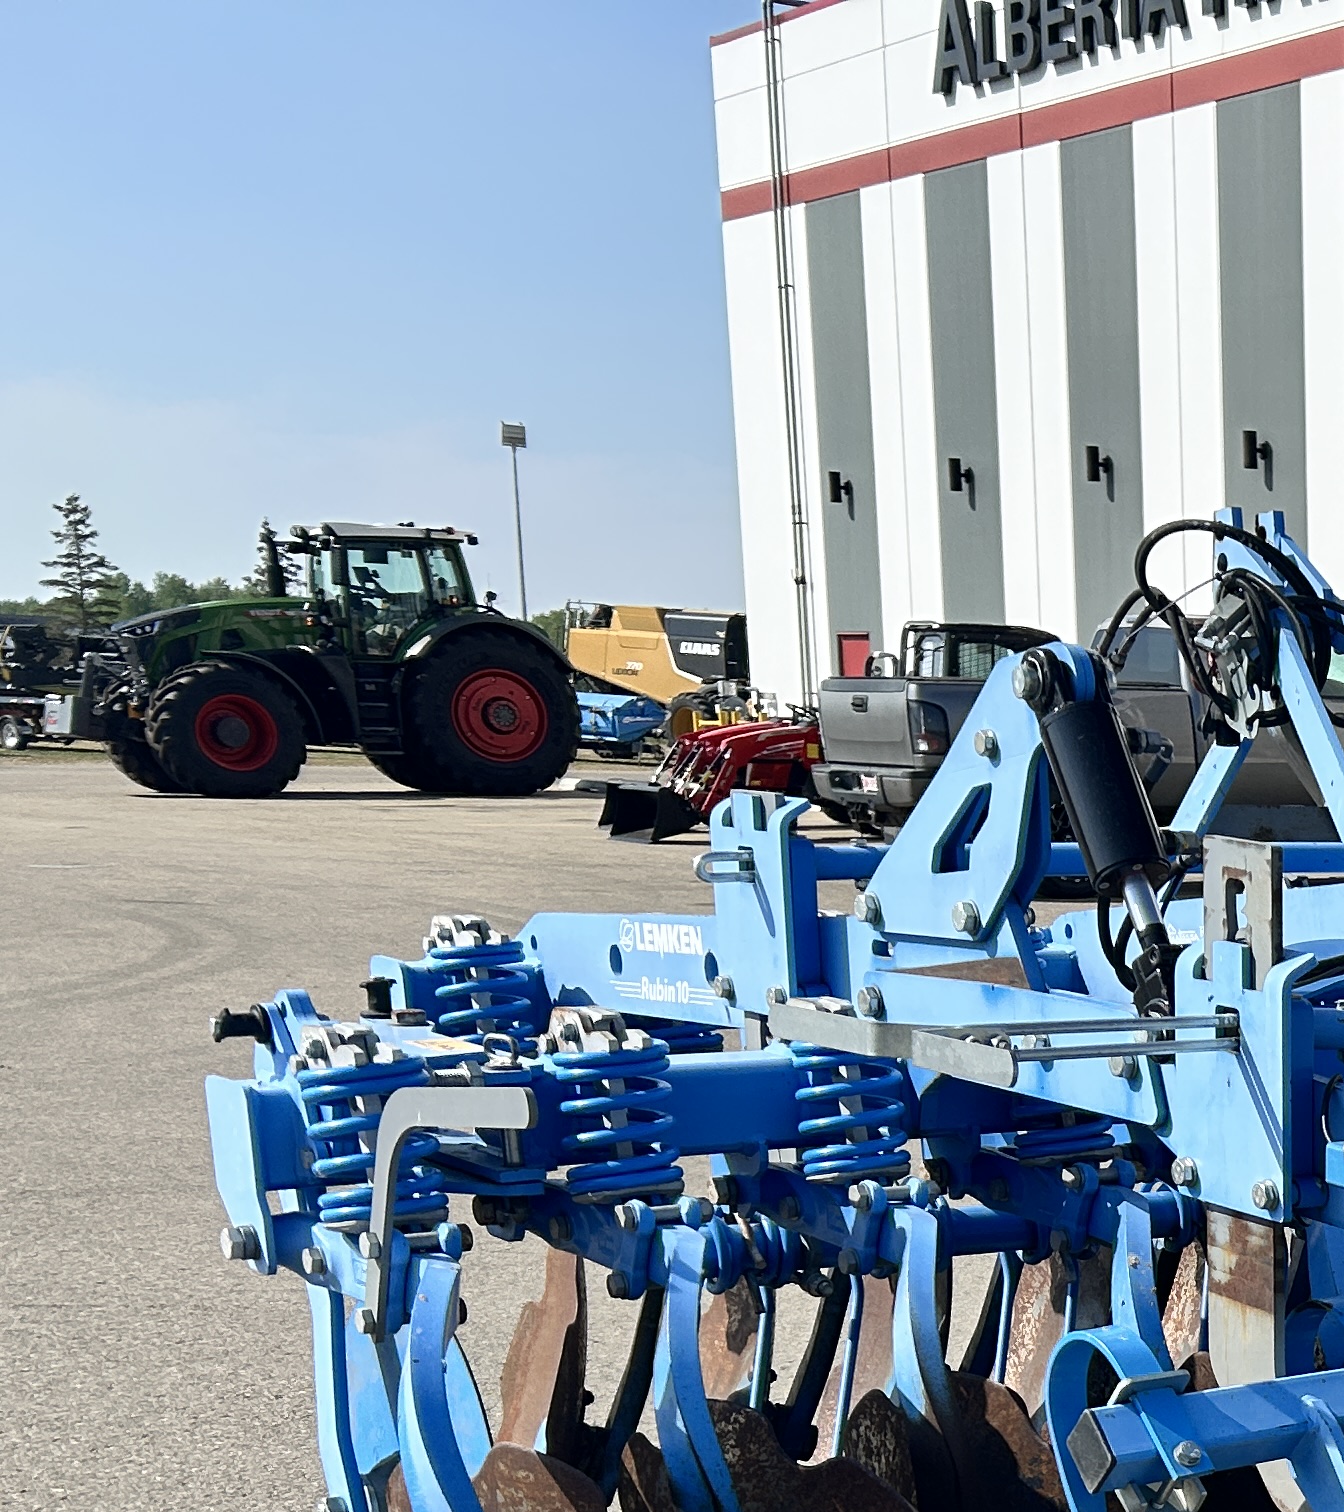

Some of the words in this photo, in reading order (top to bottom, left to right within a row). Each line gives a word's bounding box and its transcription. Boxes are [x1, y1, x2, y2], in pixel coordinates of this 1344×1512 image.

[679, 641, 721, 656] CLAAS
[633, 921, 704, 958] LEMKEN
[640, 976, 676, 1003] Rubin
[675, 979, 690, 1005] 10
